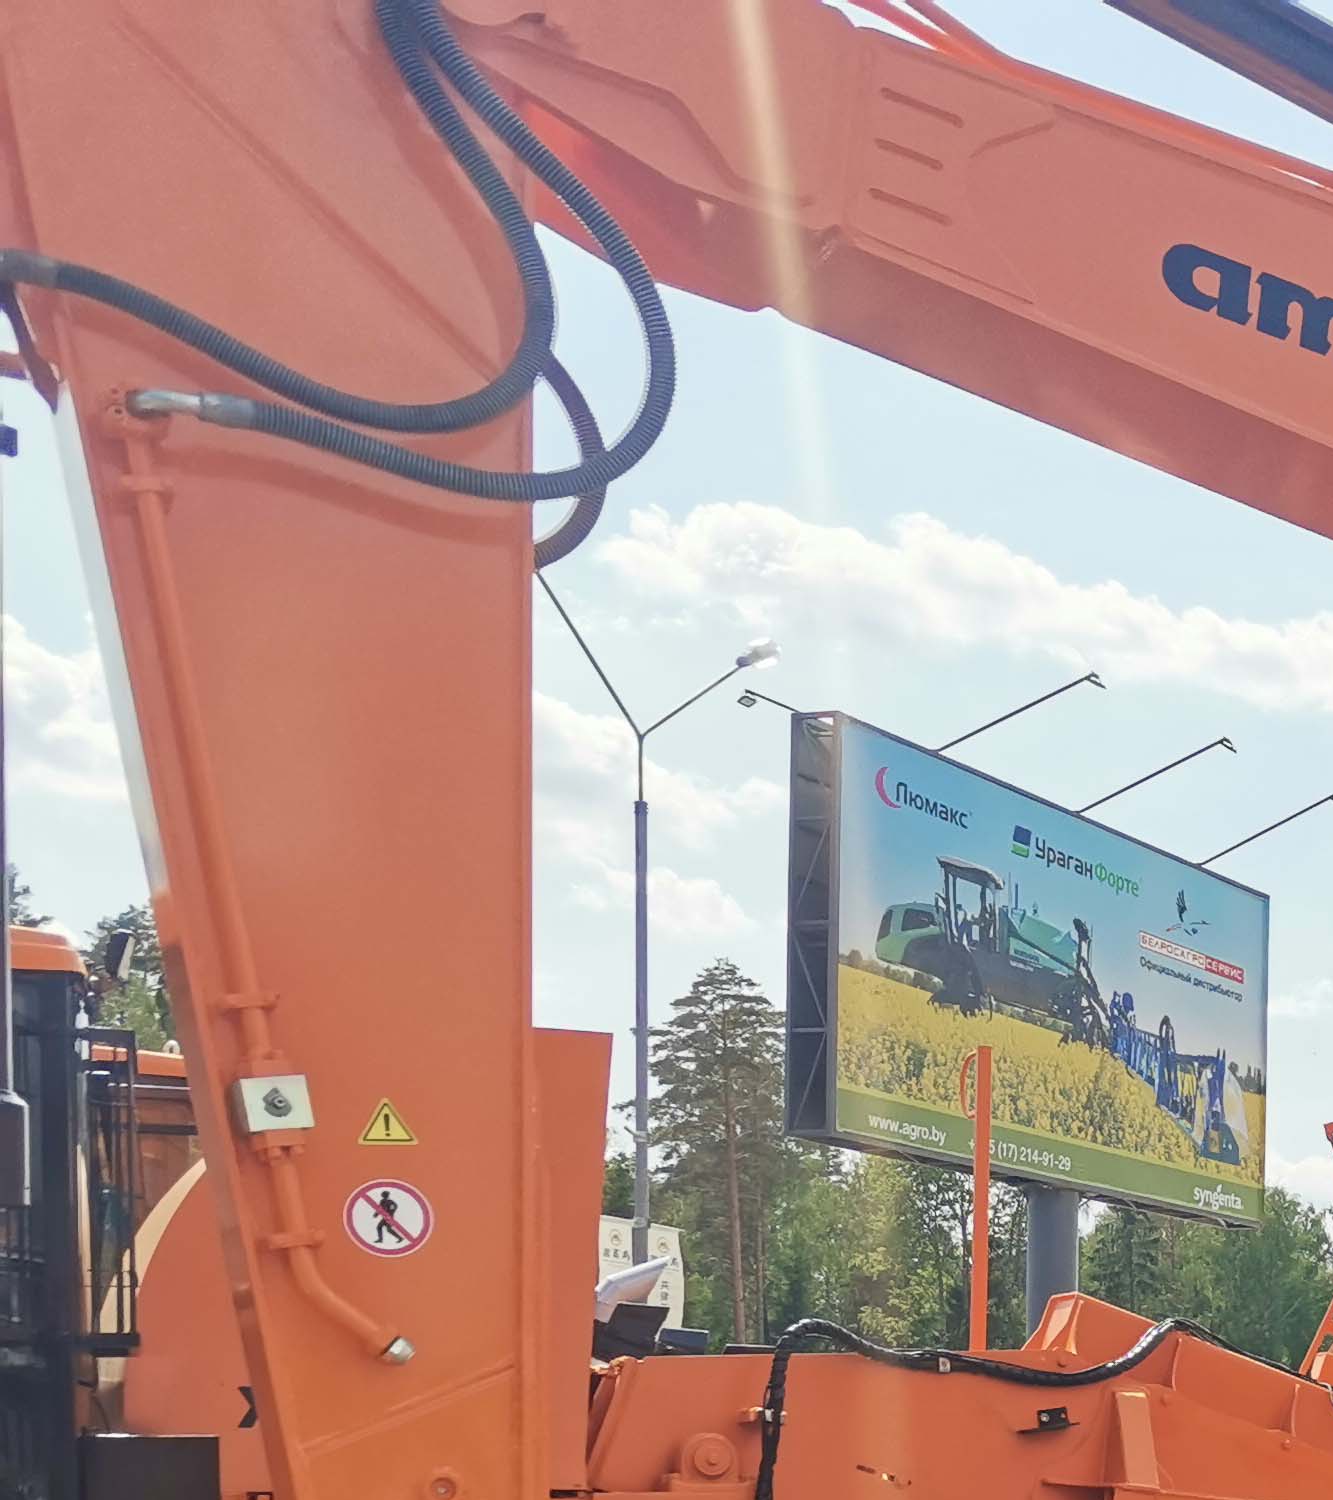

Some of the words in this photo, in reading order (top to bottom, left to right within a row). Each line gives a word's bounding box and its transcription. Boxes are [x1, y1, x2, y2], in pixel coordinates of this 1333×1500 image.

[895, 781, 969, 829] Люмакс
[868, 1114, 947, 1146] www.agro.by
[998, 1141, 1018, 1162] (17)
[1193, 1186, 1243, 1210] syngenta
